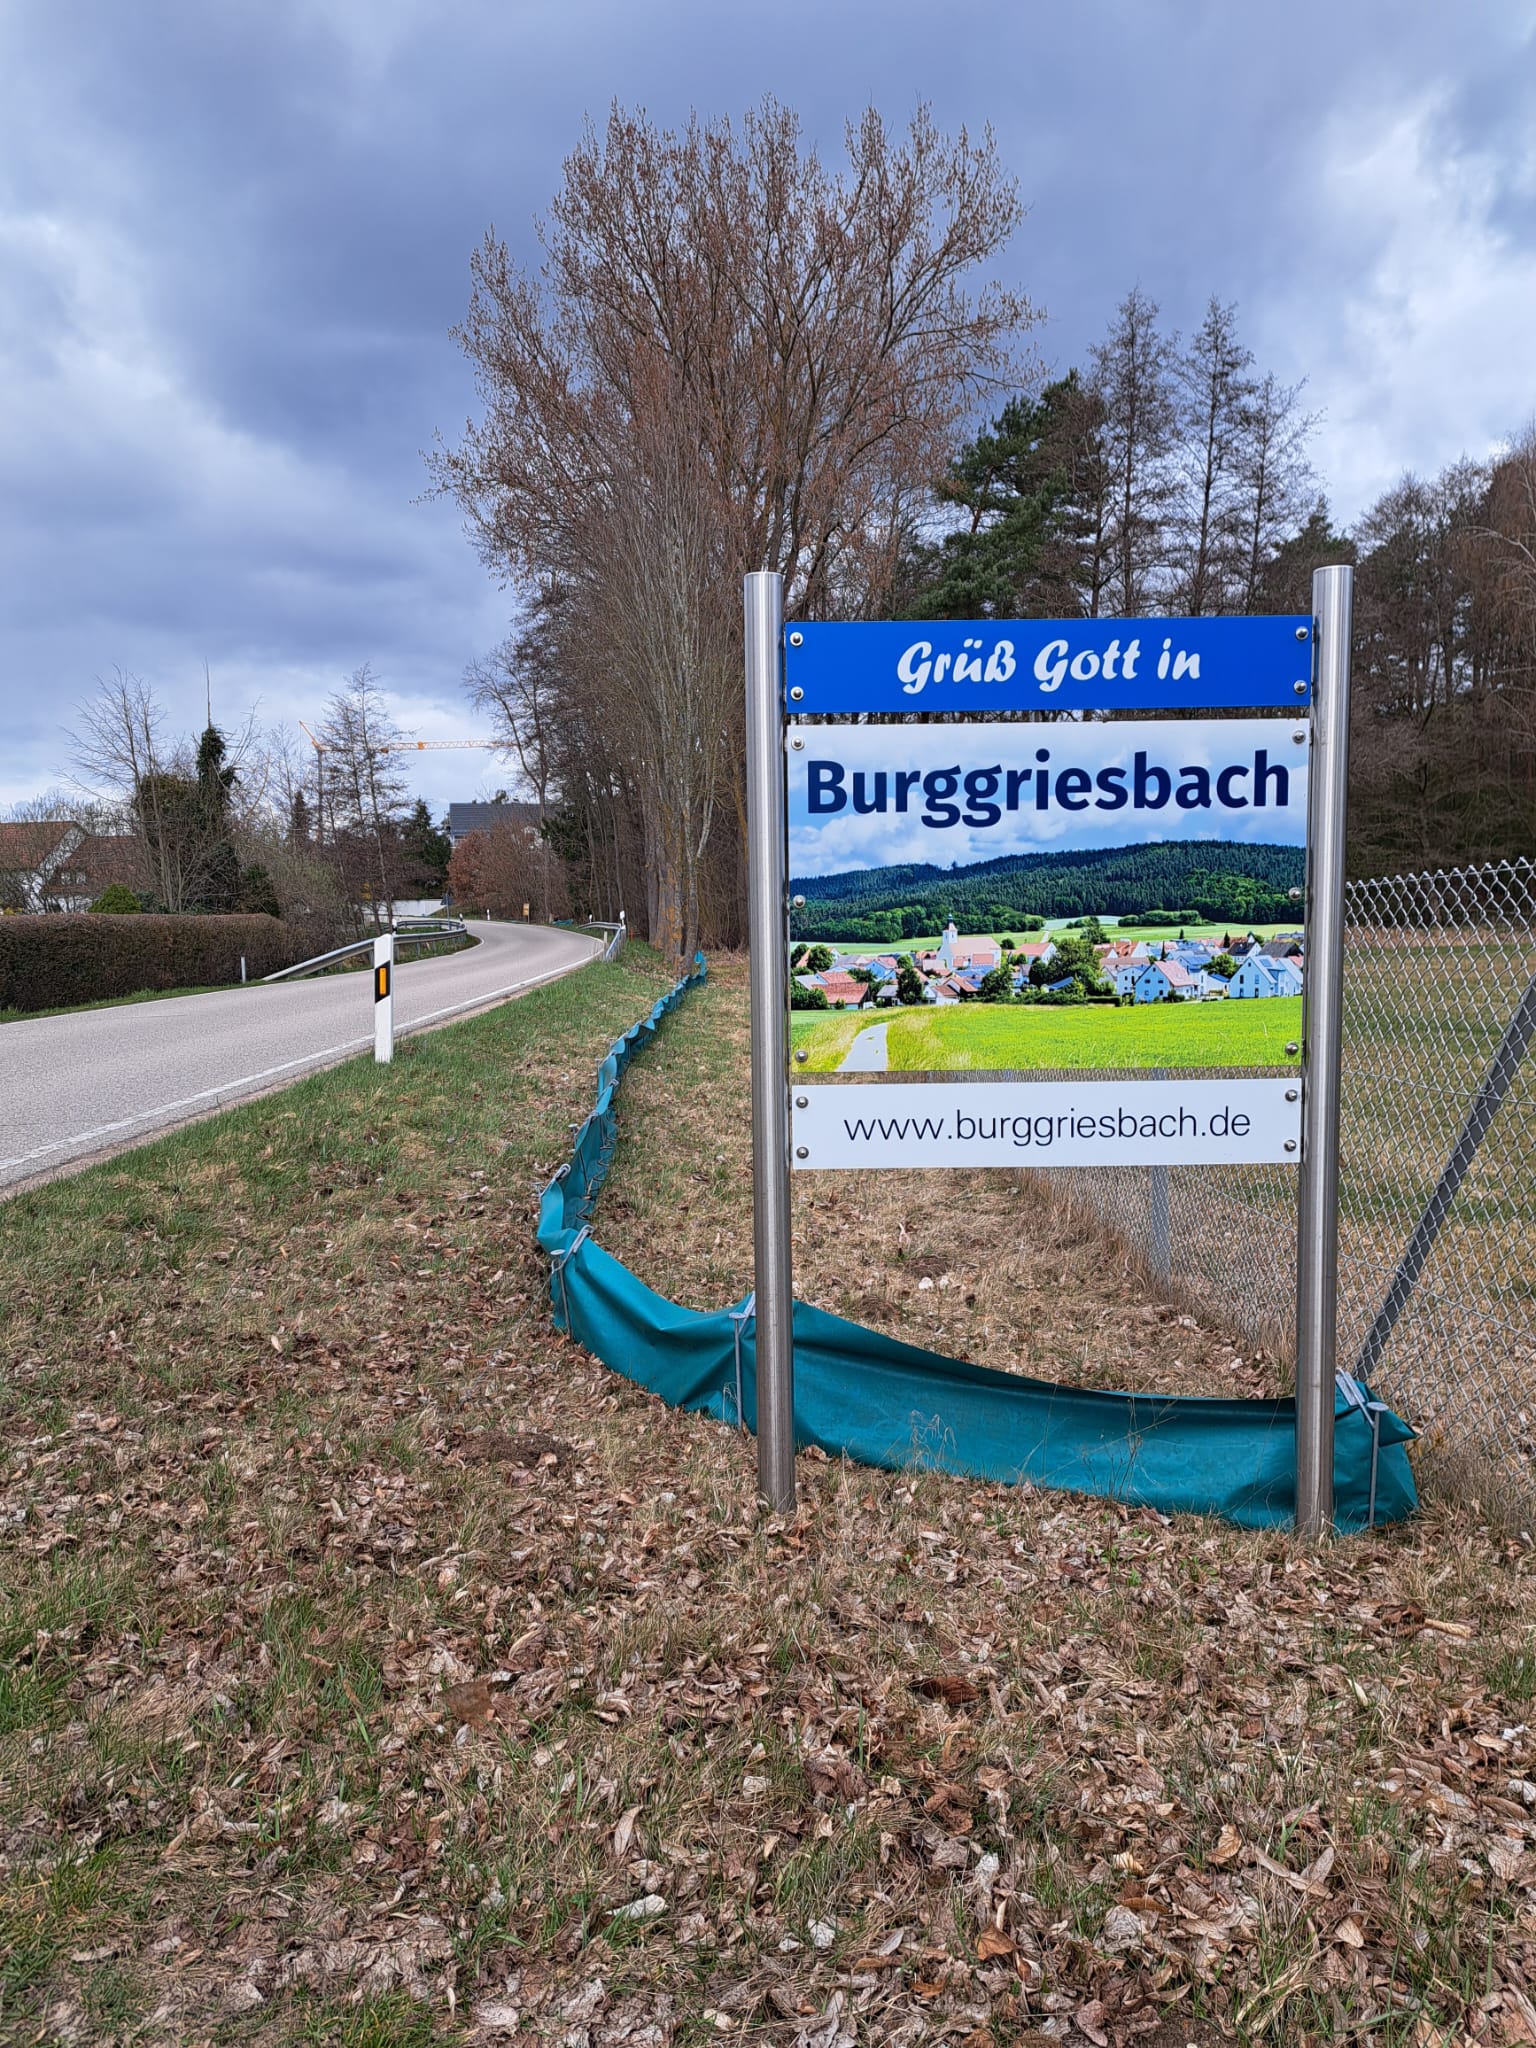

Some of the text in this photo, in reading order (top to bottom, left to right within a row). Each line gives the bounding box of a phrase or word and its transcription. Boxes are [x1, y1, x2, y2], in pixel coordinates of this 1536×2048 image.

[897, 637, 1200, 694] Grüß Gott in
[807, 748, 1289, 829] Burggriesbach
[843, 1105, 1251, 1147] www.burggriesbach.de
